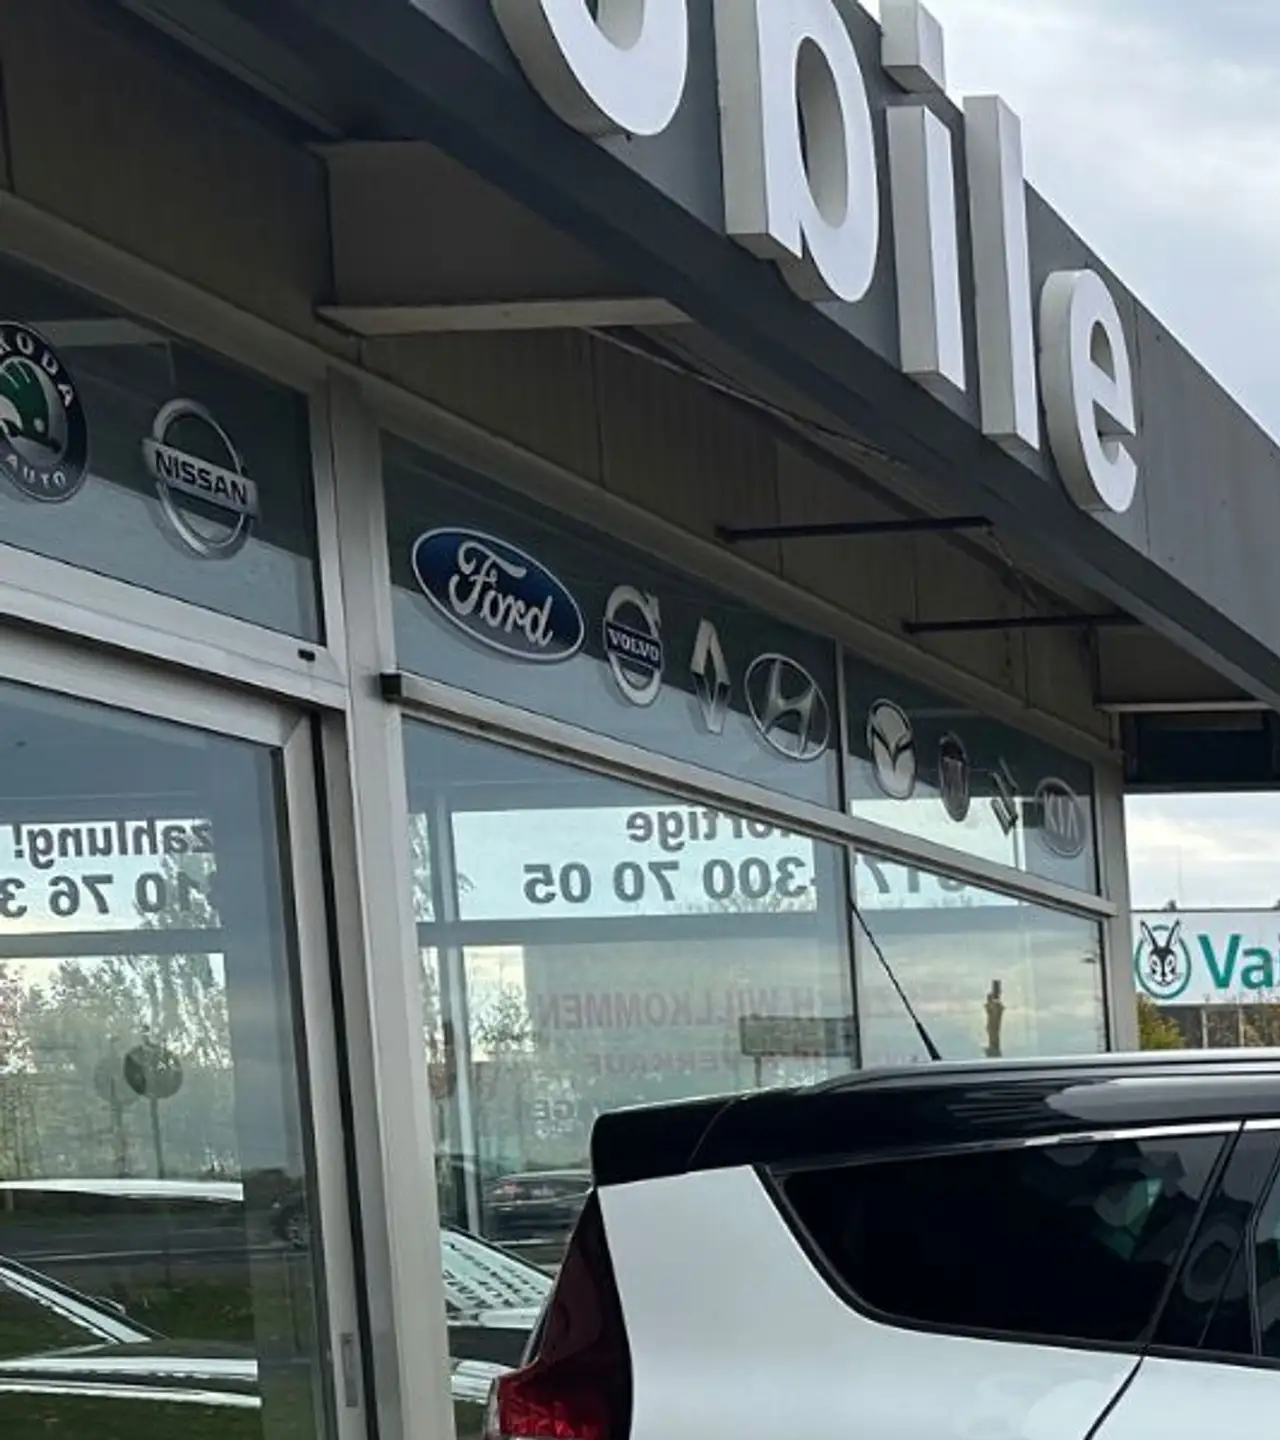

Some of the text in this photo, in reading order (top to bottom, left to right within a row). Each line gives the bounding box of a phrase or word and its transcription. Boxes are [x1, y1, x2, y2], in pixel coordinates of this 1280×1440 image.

[5, 454, 67, 490] AUTO
[155, 449, 247, 505] NISSAN
[449, 540, 554, 647] Ford
[607, 628, 660, 662] VOLVO
